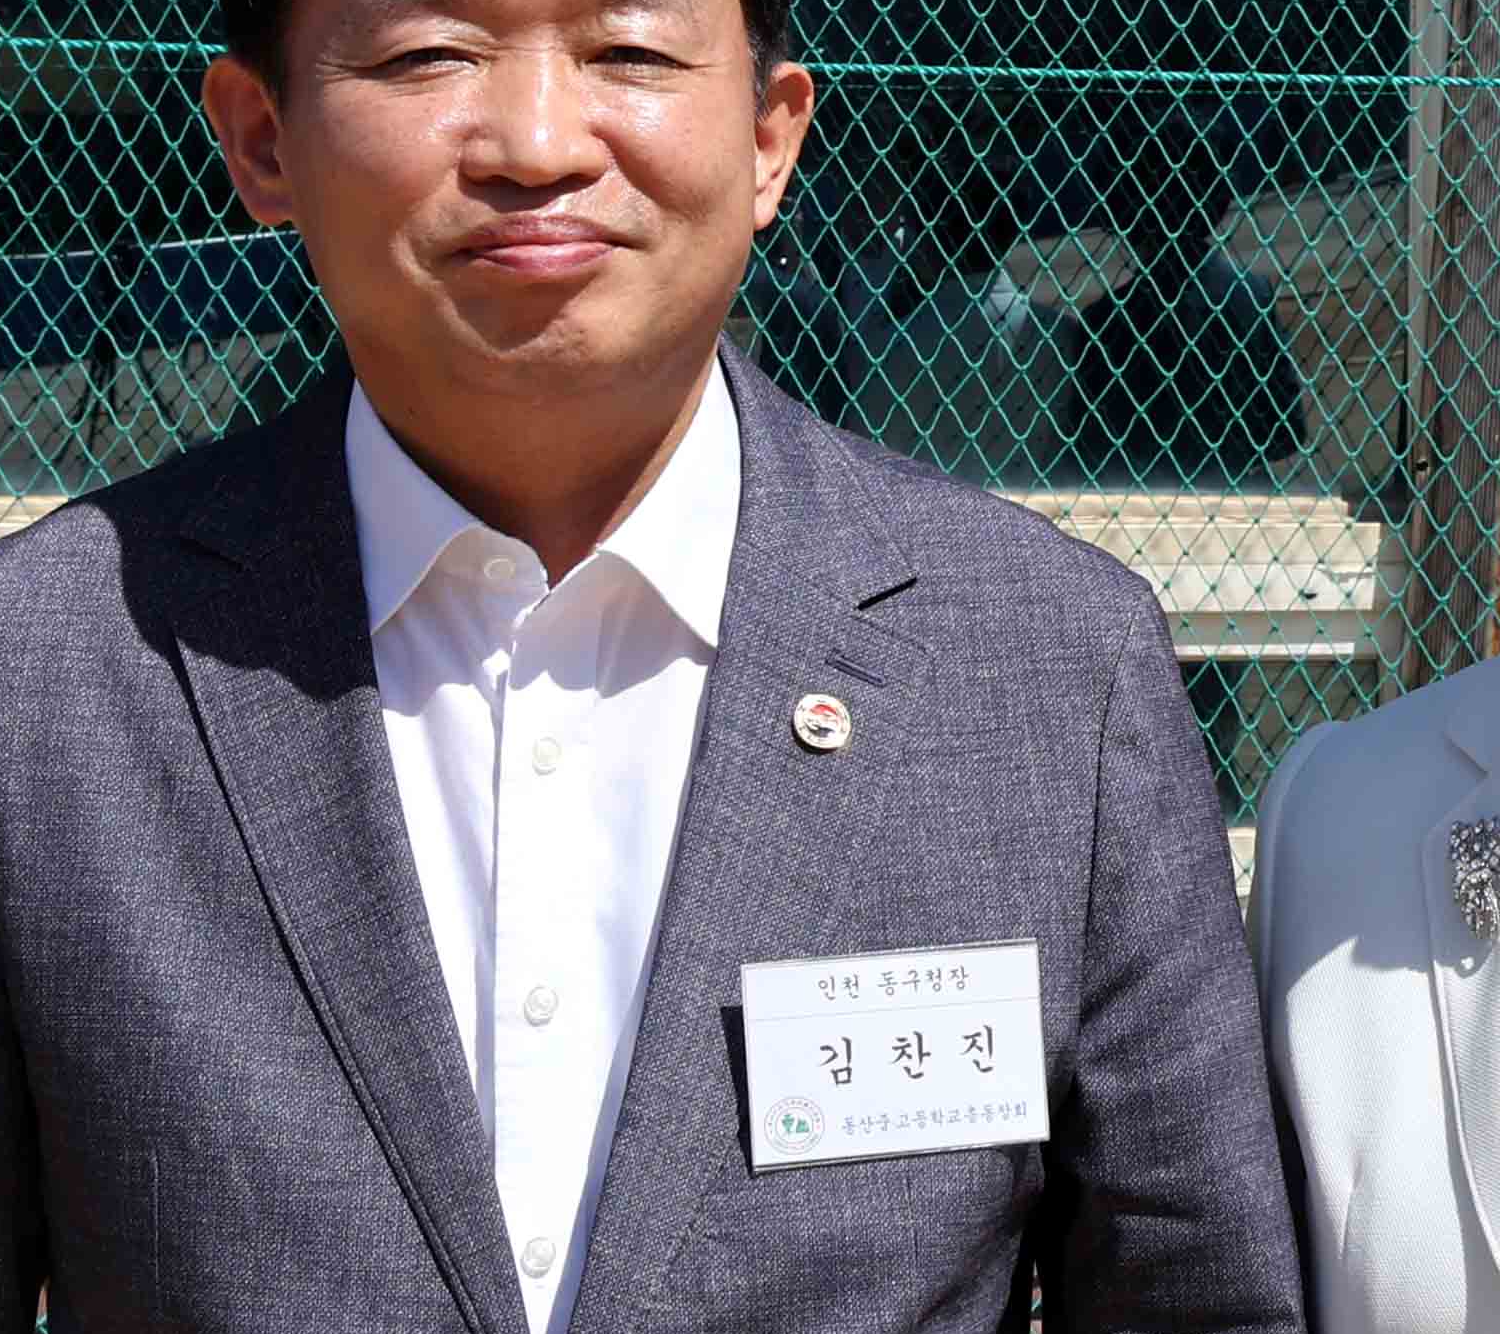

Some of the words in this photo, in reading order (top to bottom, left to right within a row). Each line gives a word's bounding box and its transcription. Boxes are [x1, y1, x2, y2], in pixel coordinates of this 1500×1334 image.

[817, 974, 861, 1001] 인천
[876, 965, 971, 997] 동구청장
[819, 1024, 996, 1086] 김찬진
